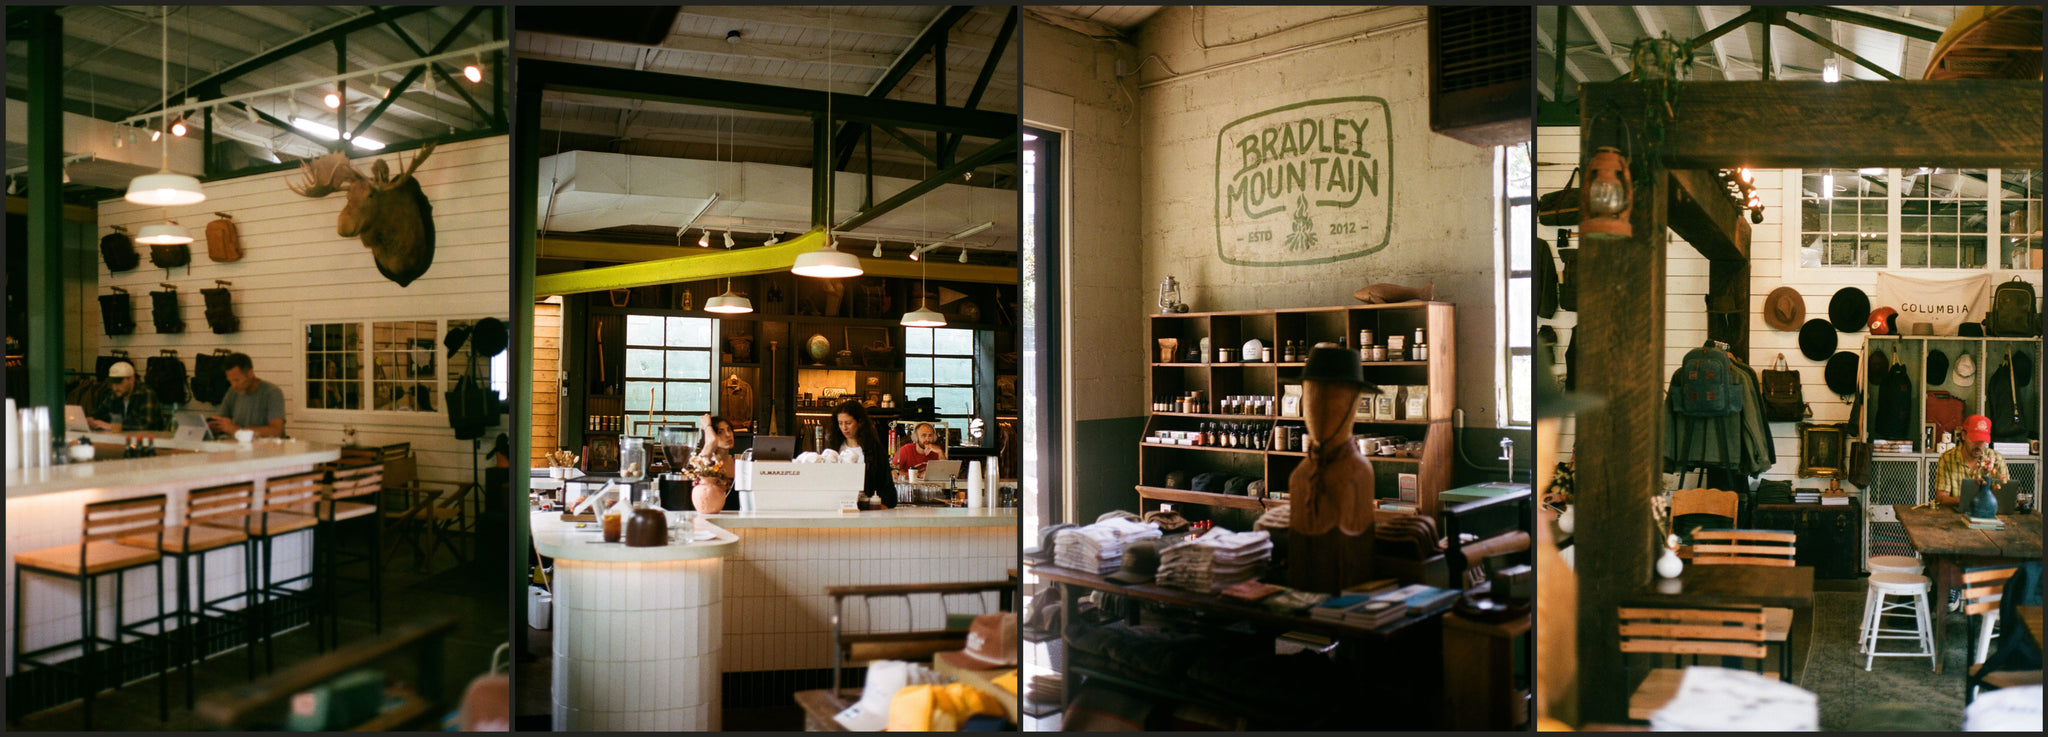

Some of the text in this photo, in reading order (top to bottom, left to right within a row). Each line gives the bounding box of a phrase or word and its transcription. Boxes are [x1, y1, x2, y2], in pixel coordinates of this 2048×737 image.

[1233, 118, 1371, 182] BRADLEY
[1227, 157, 1379, 219] MOUNTAIN
[1248, 222, 1356, 243] ESTD 2012
[1901, 303, 1969, 314] COLUMBIA
